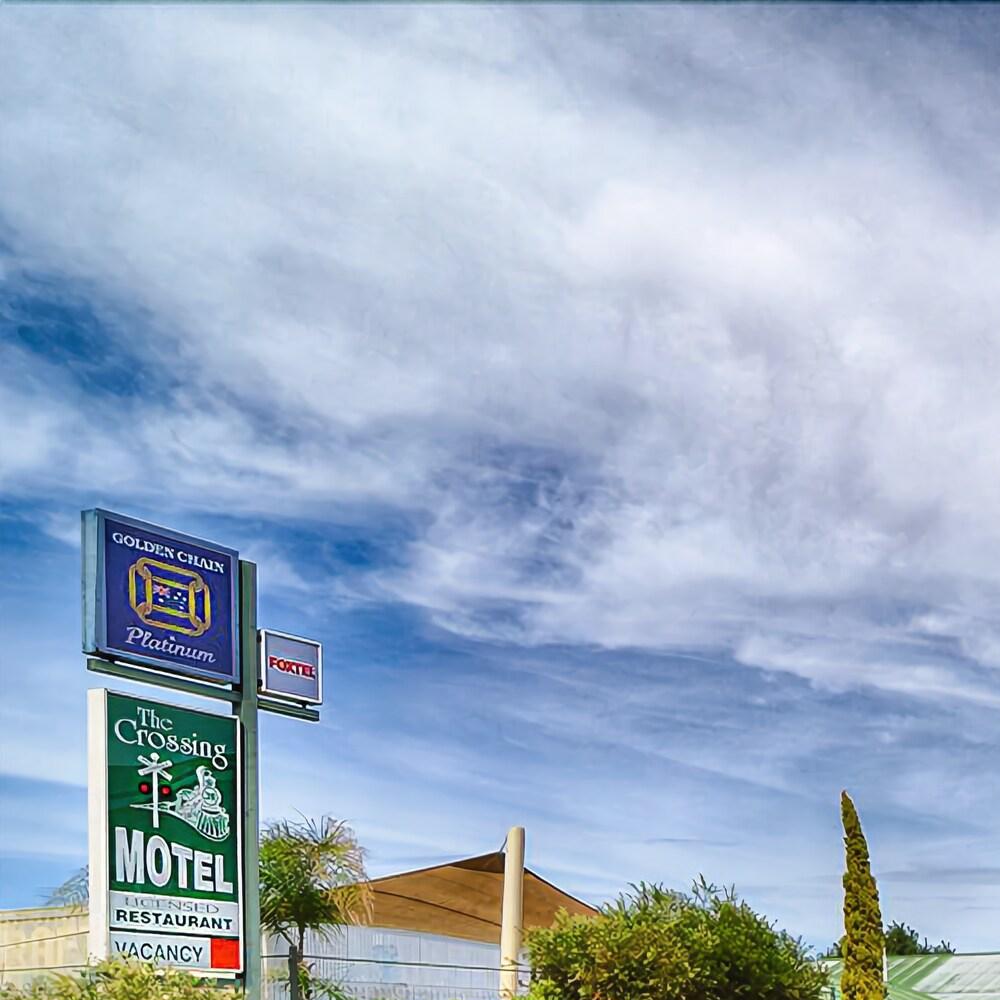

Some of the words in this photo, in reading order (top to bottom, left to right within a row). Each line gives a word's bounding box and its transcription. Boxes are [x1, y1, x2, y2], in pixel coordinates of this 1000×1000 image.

[112, 532, 174, 558] GOLDEN
[177, 551, 225, 574] CHAIN
[125, 626, 216, 664] Platinum
[269, 656, 316, 678] FOXTEL
[137, 706, 173, 731] The
[114, 718, 228, 771] Crossing
[114, 826, 233, 894] MOTEL
[124, 896, 220, 914] LICENSED
[115, 909, 233, 930] RESTAURANT
[114, 940, 203, 963] VACANCY
